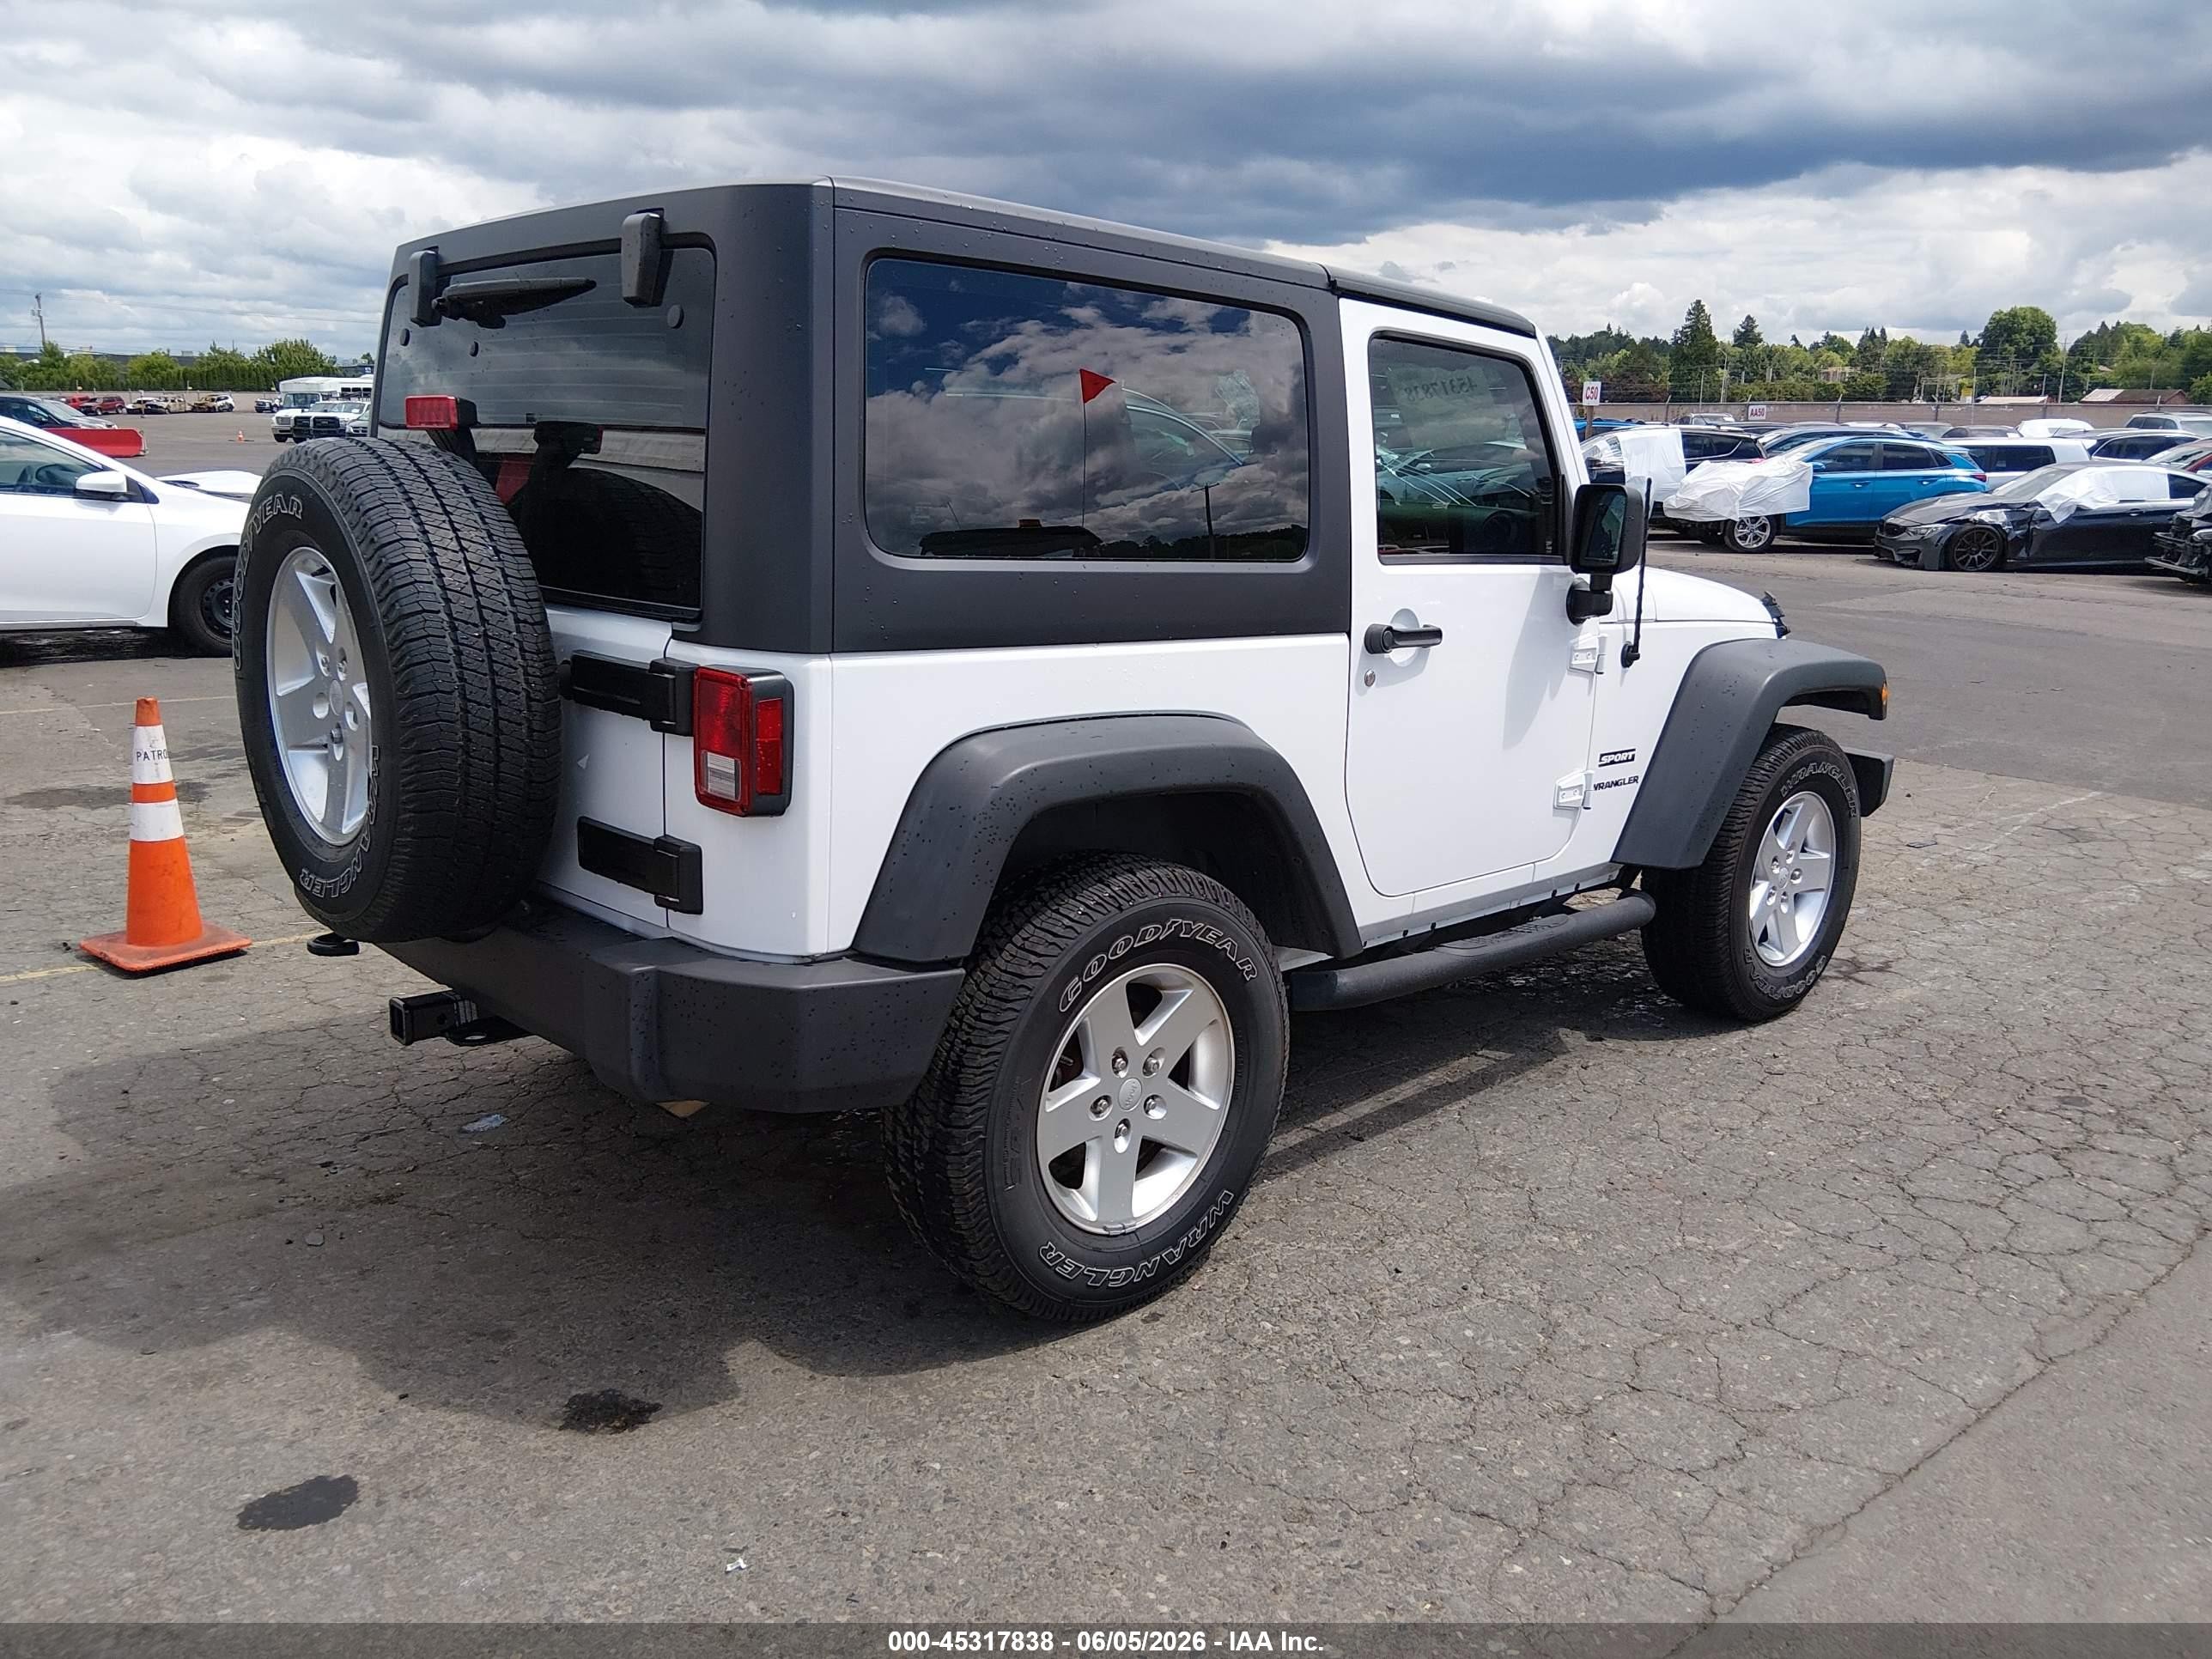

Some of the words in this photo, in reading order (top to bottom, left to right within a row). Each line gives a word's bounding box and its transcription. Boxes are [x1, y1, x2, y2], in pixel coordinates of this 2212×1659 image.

[1585, 386, 1598, 400] C50
[1750, 408, 1765, 417] AA50
[1599, 750, 1636, 765] SPORT
[1780, 762, 1857, 817] WRANGLER
[1059, 919, 1258, 1012] GOODYEAR
[1039, 1190, 1234, 1287] WRANGLER
